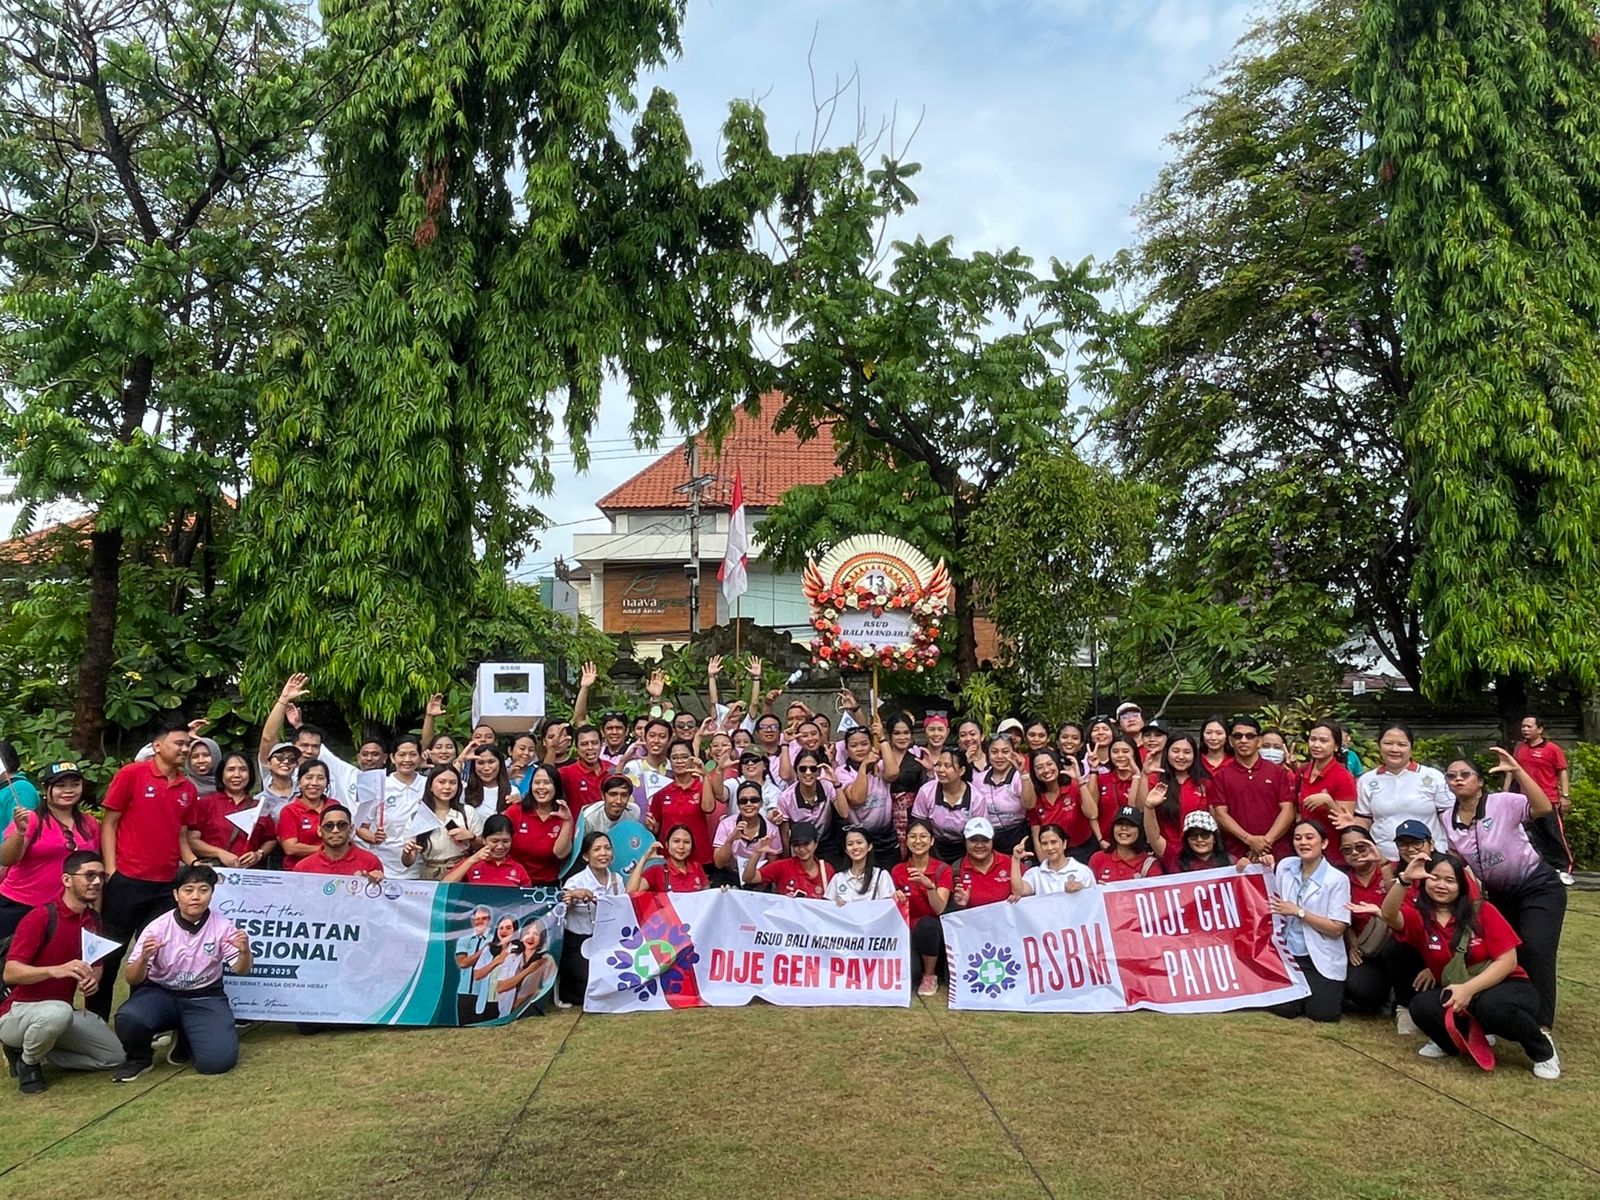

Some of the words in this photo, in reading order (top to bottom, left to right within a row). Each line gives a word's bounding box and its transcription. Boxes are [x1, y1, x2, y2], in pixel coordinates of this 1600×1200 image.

[866, 574, 885, 589] 13
[865, 630, 910, 638] MANDARA
[218, 899, 278, 918] Selamat
[277, 903, 305, 918] Hari
[1135, 888, 1189, 938] DIJE
[1194, 881, 1241, 932] GEN
[228, 917, 360, 941] ESEHATAN
[250, 940, 338, 961] SIONAL
[754, 931, 783, 946] RSUD
[785, 934, 809, 948] BALI
[811, 935, 864, 950] MANDARA
[868, 937, 898, 951] TEAM
[709, 948, 765, 984] DIJE
[773, 954, 820, 987] GEN
[829, 957, 902, 990] PAYU!
[1022, 922, 1113, 995] RSBM
[270, 968, 291, 976] 2025
[1163, 944, 1239, 997] PAYU!
